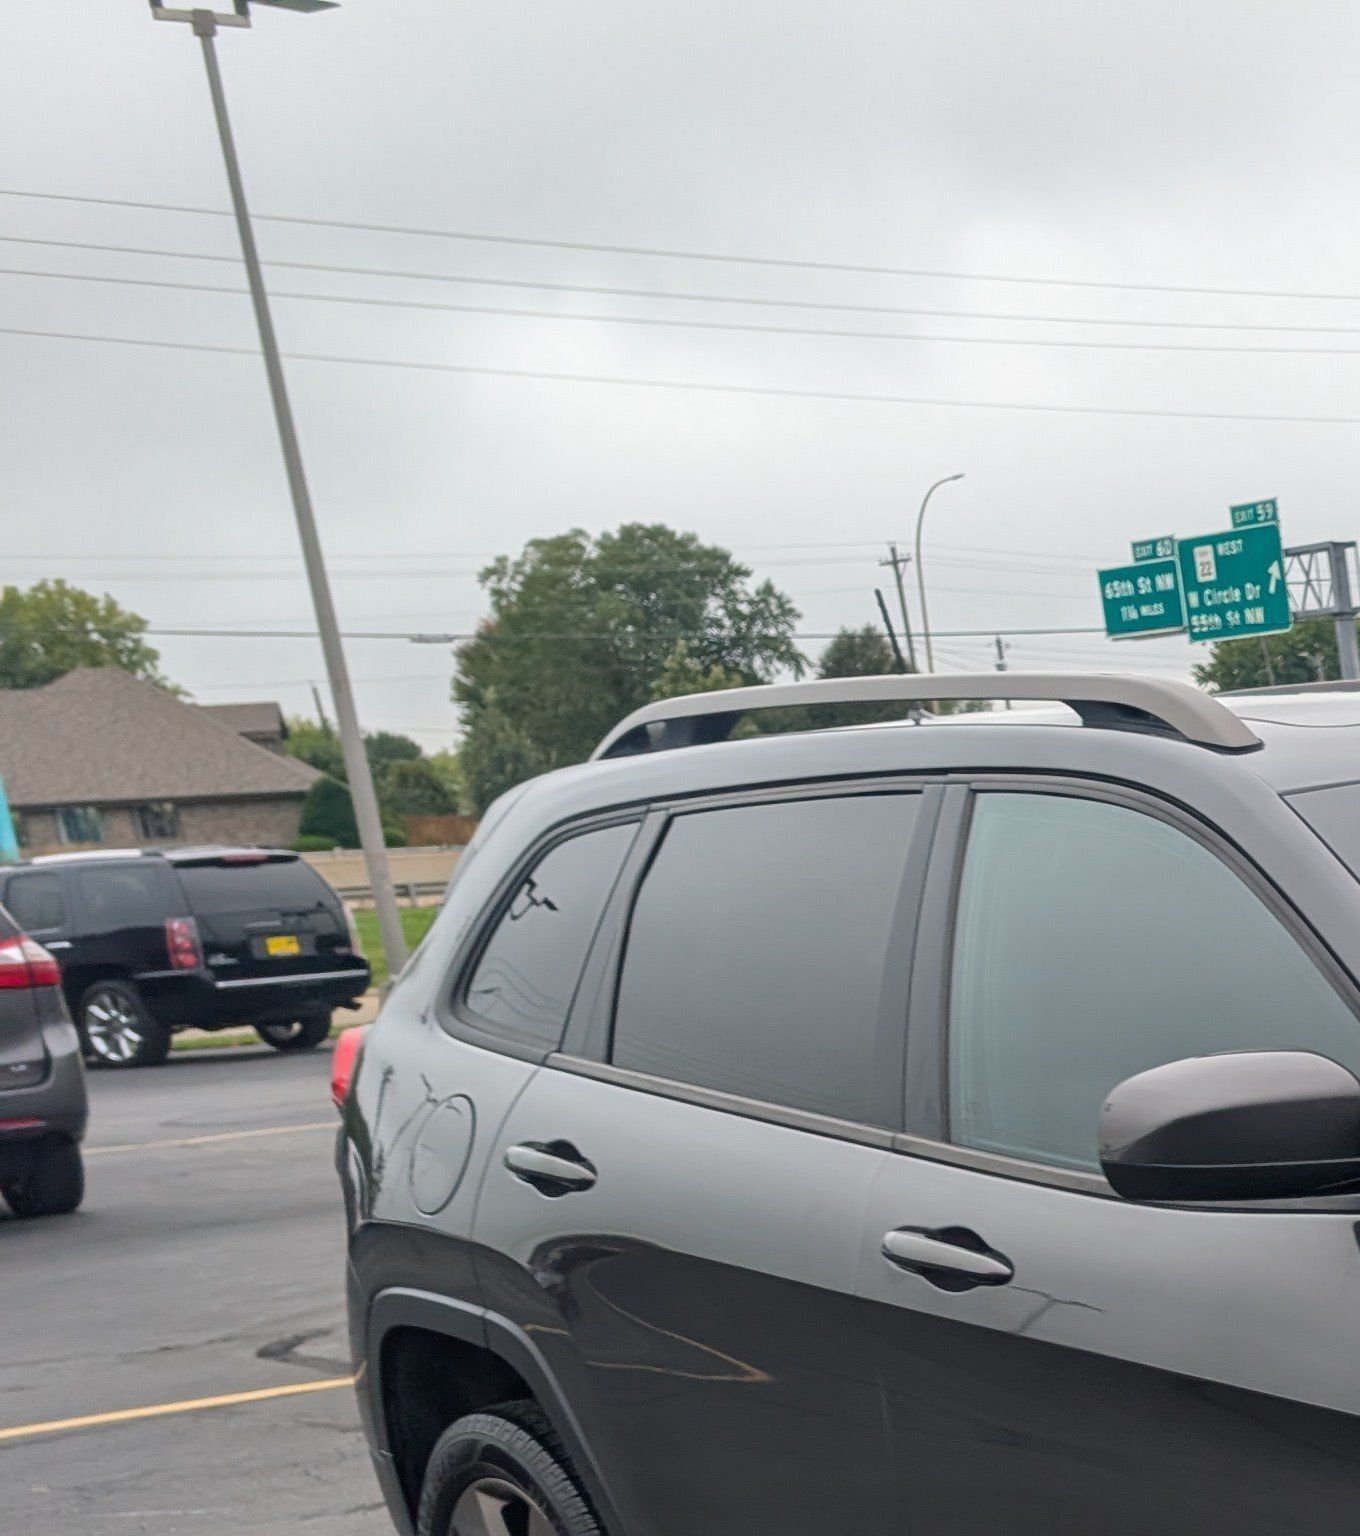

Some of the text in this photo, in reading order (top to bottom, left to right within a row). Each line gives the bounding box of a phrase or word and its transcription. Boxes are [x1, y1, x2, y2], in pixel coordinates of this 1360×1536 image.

[1256, 502, 1274, 521] 59
[1199, 560, 1213, 578] 22
[1137, 576, 1152, 595] St
[1203, 586, 1241, 606] Circle
[1245, 582, 1261, 601] Dr
[1225, 610, 1240, 627] St
